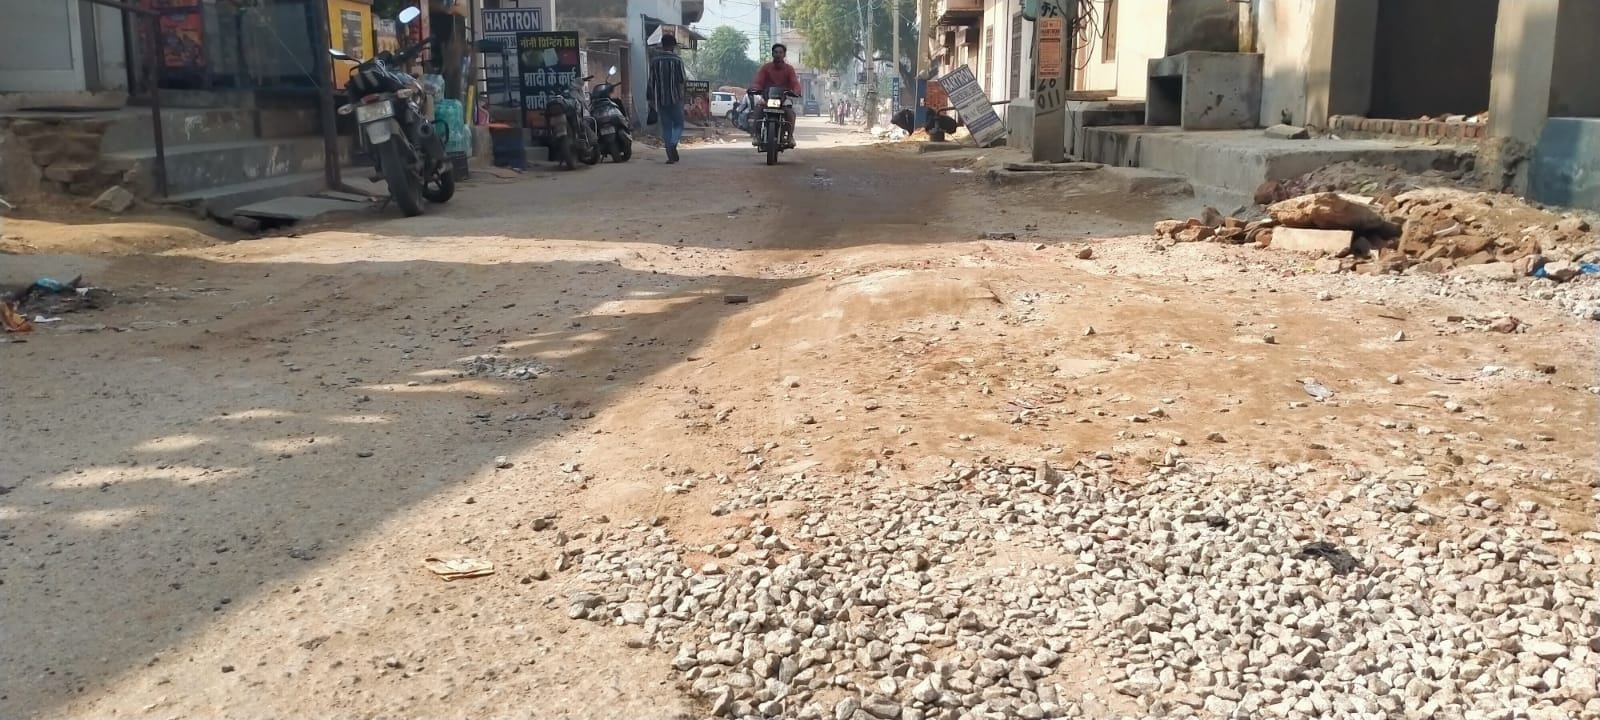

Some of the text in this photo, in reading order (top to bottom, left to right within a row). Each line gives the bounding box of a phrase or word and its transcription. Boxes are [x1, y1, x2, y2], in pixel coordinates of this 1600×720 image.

[485, 11, 540, 30] HARTRON
[524, 68, 546, 87] शादी
[548, 68, 557, 87] के
[941, 68, 975, 94] HARTRON
[525, 91, 547, 109] शादी
